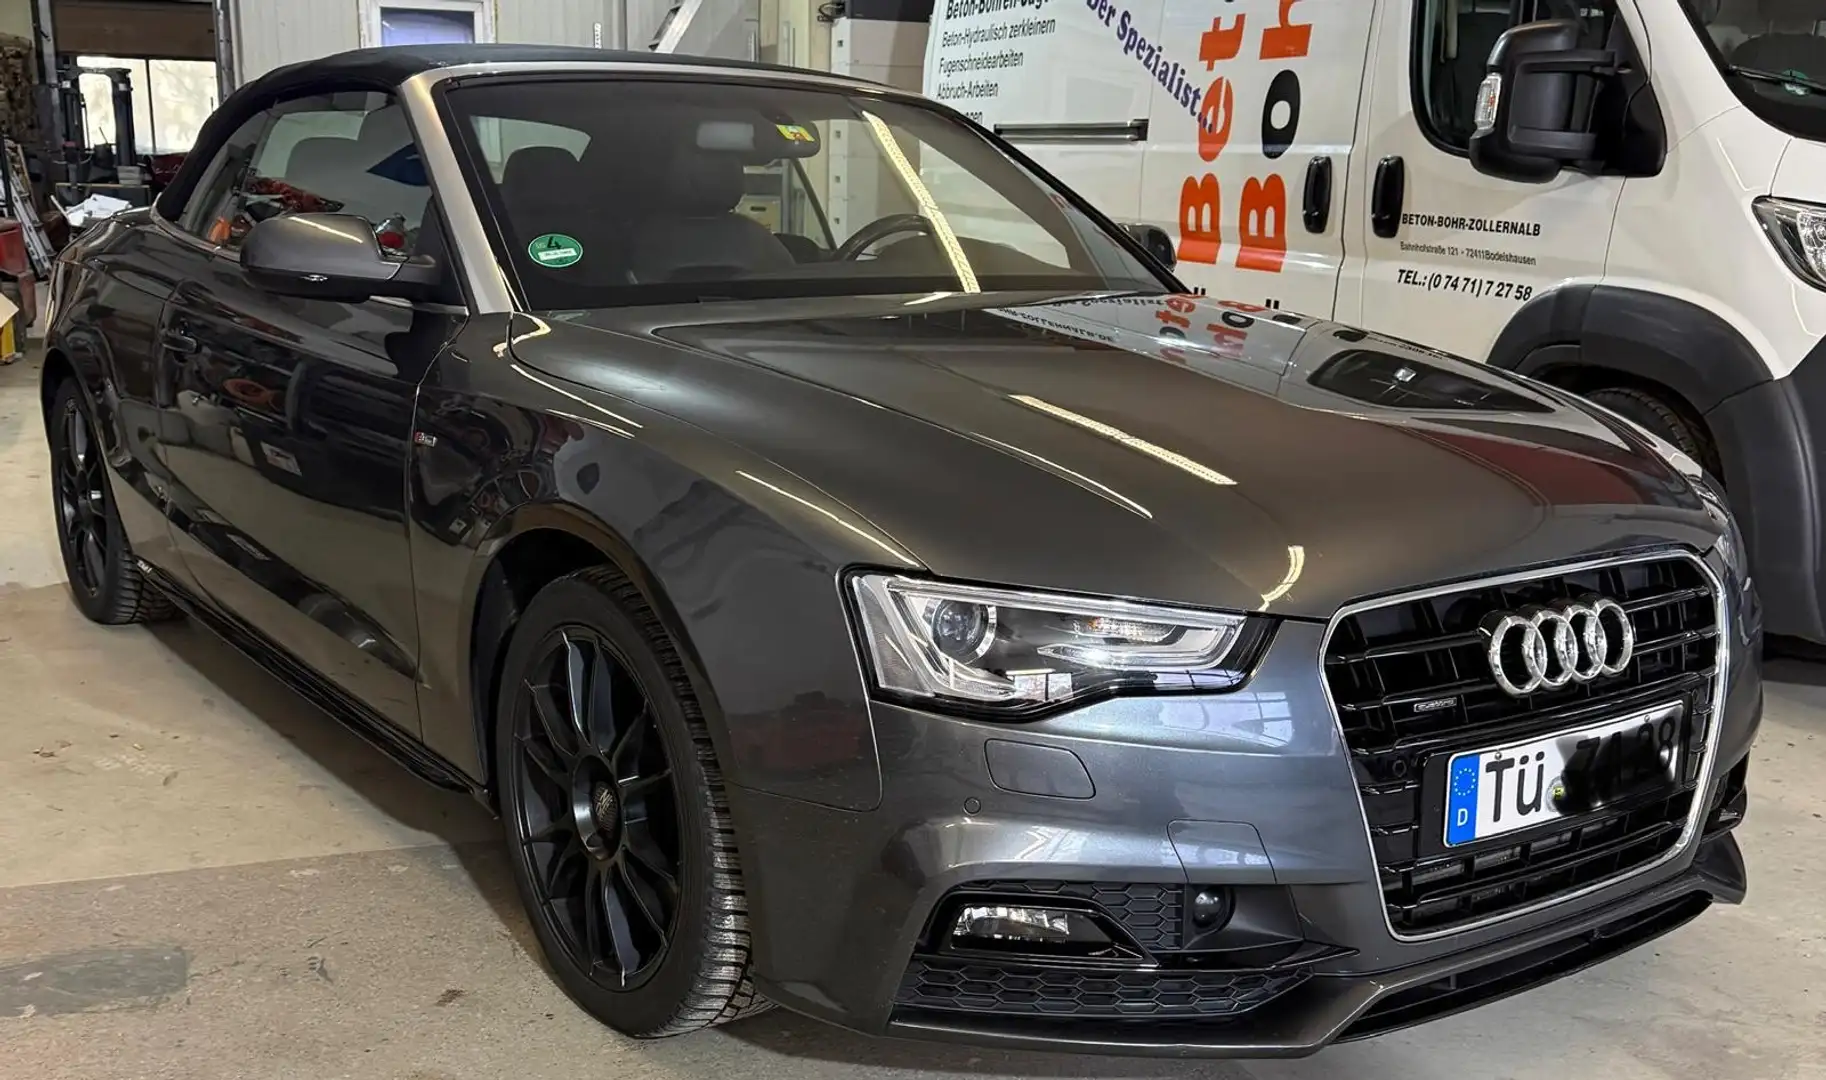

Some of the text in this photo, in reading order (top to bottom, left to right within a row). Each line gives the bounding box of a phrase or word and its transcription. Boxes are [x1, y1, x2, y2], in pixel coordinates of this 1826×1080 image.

[942, 17, 1055, 48] Beton-Hydraulisch zerkleinern
[938, 50, 1023, 77] Fugenschneidearbeiten
[936, 79, 998, 100] Abbruch-Arbeiten
[1402, 213, 1541, 236] BETON-BOHR-ZOLLERNALB
[1447, 247, 1459, 256] 121
[1485, 751, 1545, 823] Tü
[1457, 808, 1468, 826] D
